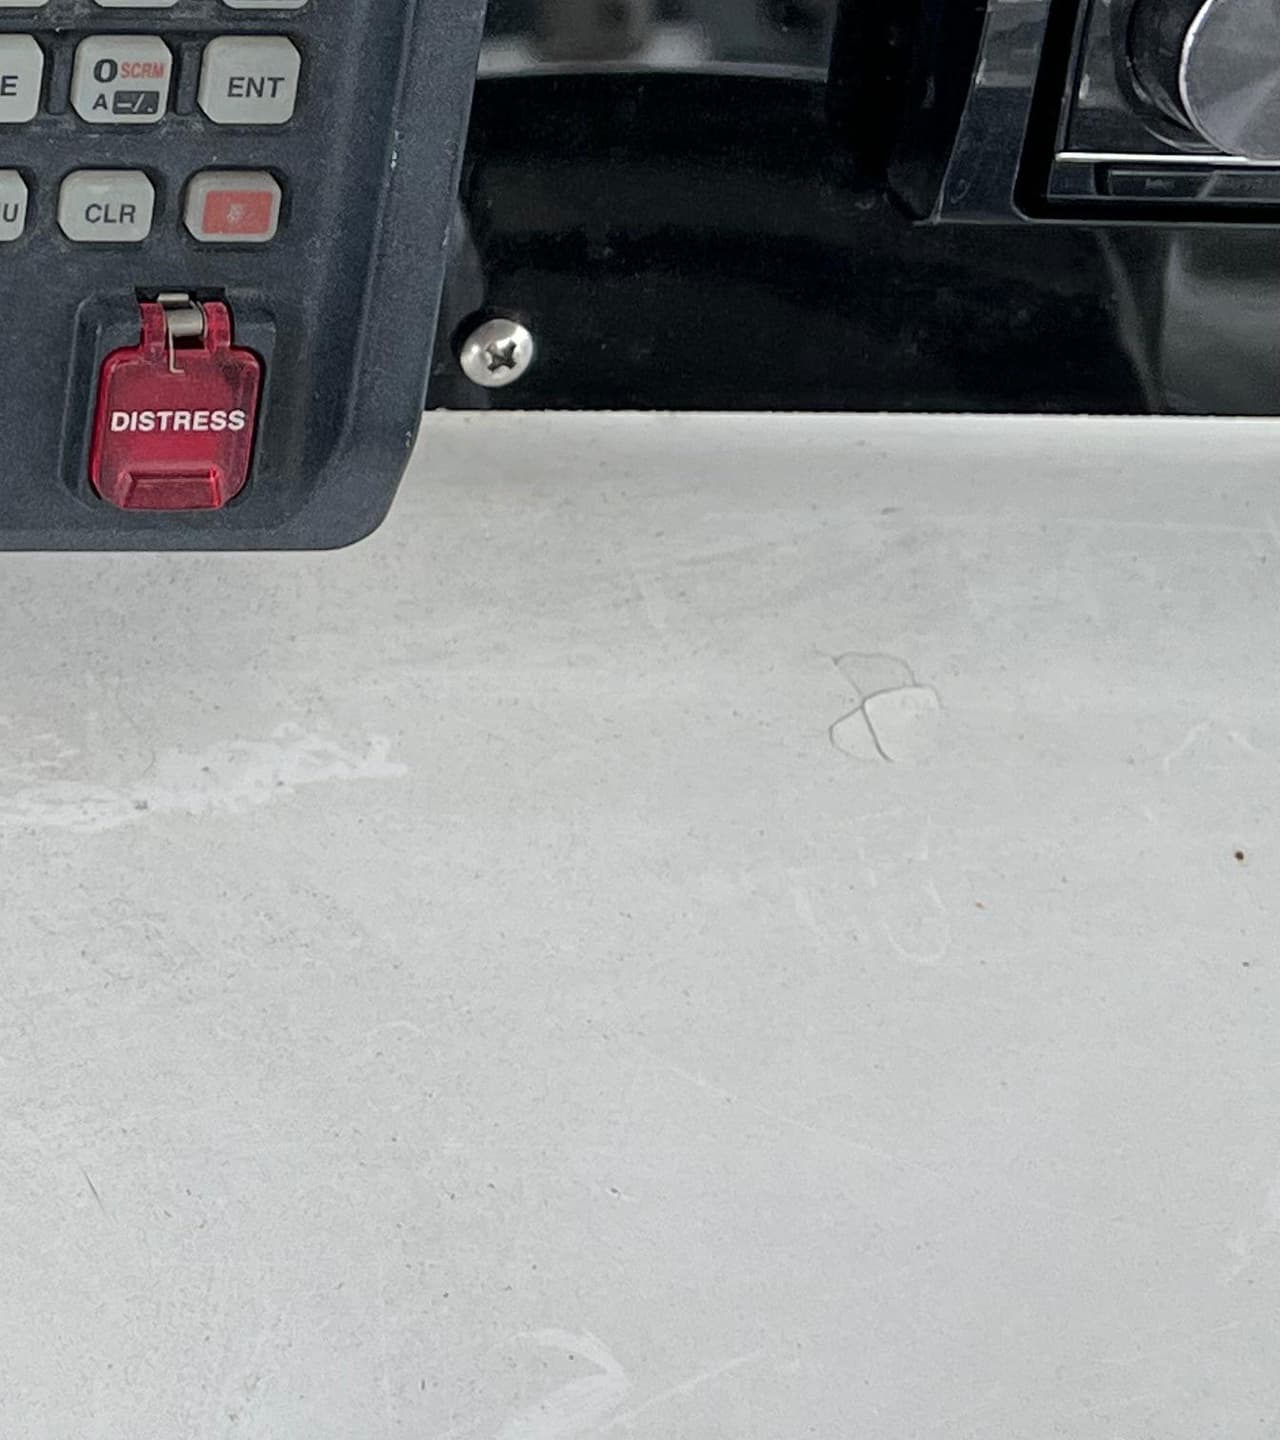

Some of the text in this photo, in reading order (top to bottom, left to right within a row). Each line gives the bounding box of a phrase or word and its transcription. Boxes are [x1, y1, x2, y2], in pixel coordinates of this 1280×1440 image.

[226, 76, 285, 99] ENT
[84, 202, 137, 224] CLR
[109, 410, 246, 433] DISTRESS
